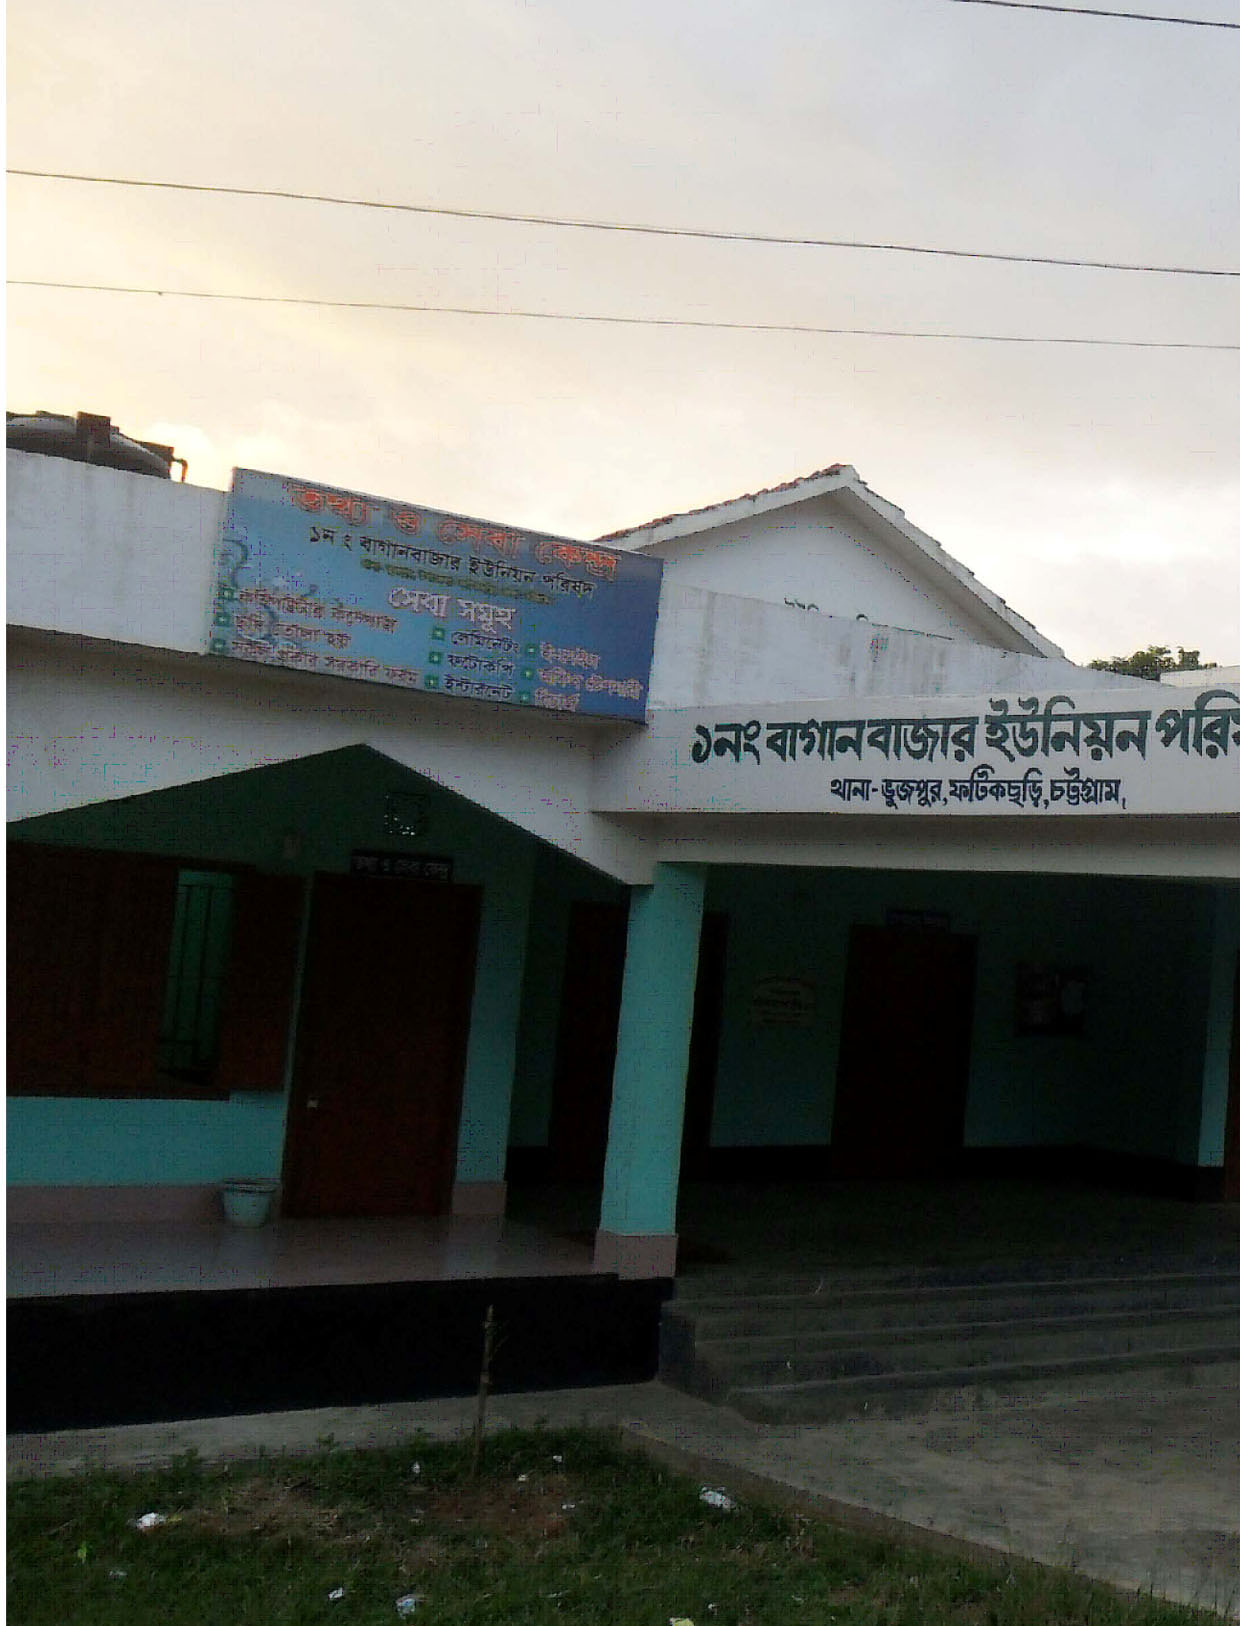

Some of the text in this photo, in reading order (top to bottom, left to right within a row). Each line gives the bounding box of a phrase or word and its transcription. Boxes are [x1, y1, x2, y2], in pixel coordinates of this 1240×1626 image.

[468, 555, 537, 583] ইউনিয়ন
[542, 571, 597, 598] পরিষদ
[691, 719, 761, 765] ১নং
[984, 696, 1152, 762] ইউনিয়ন
